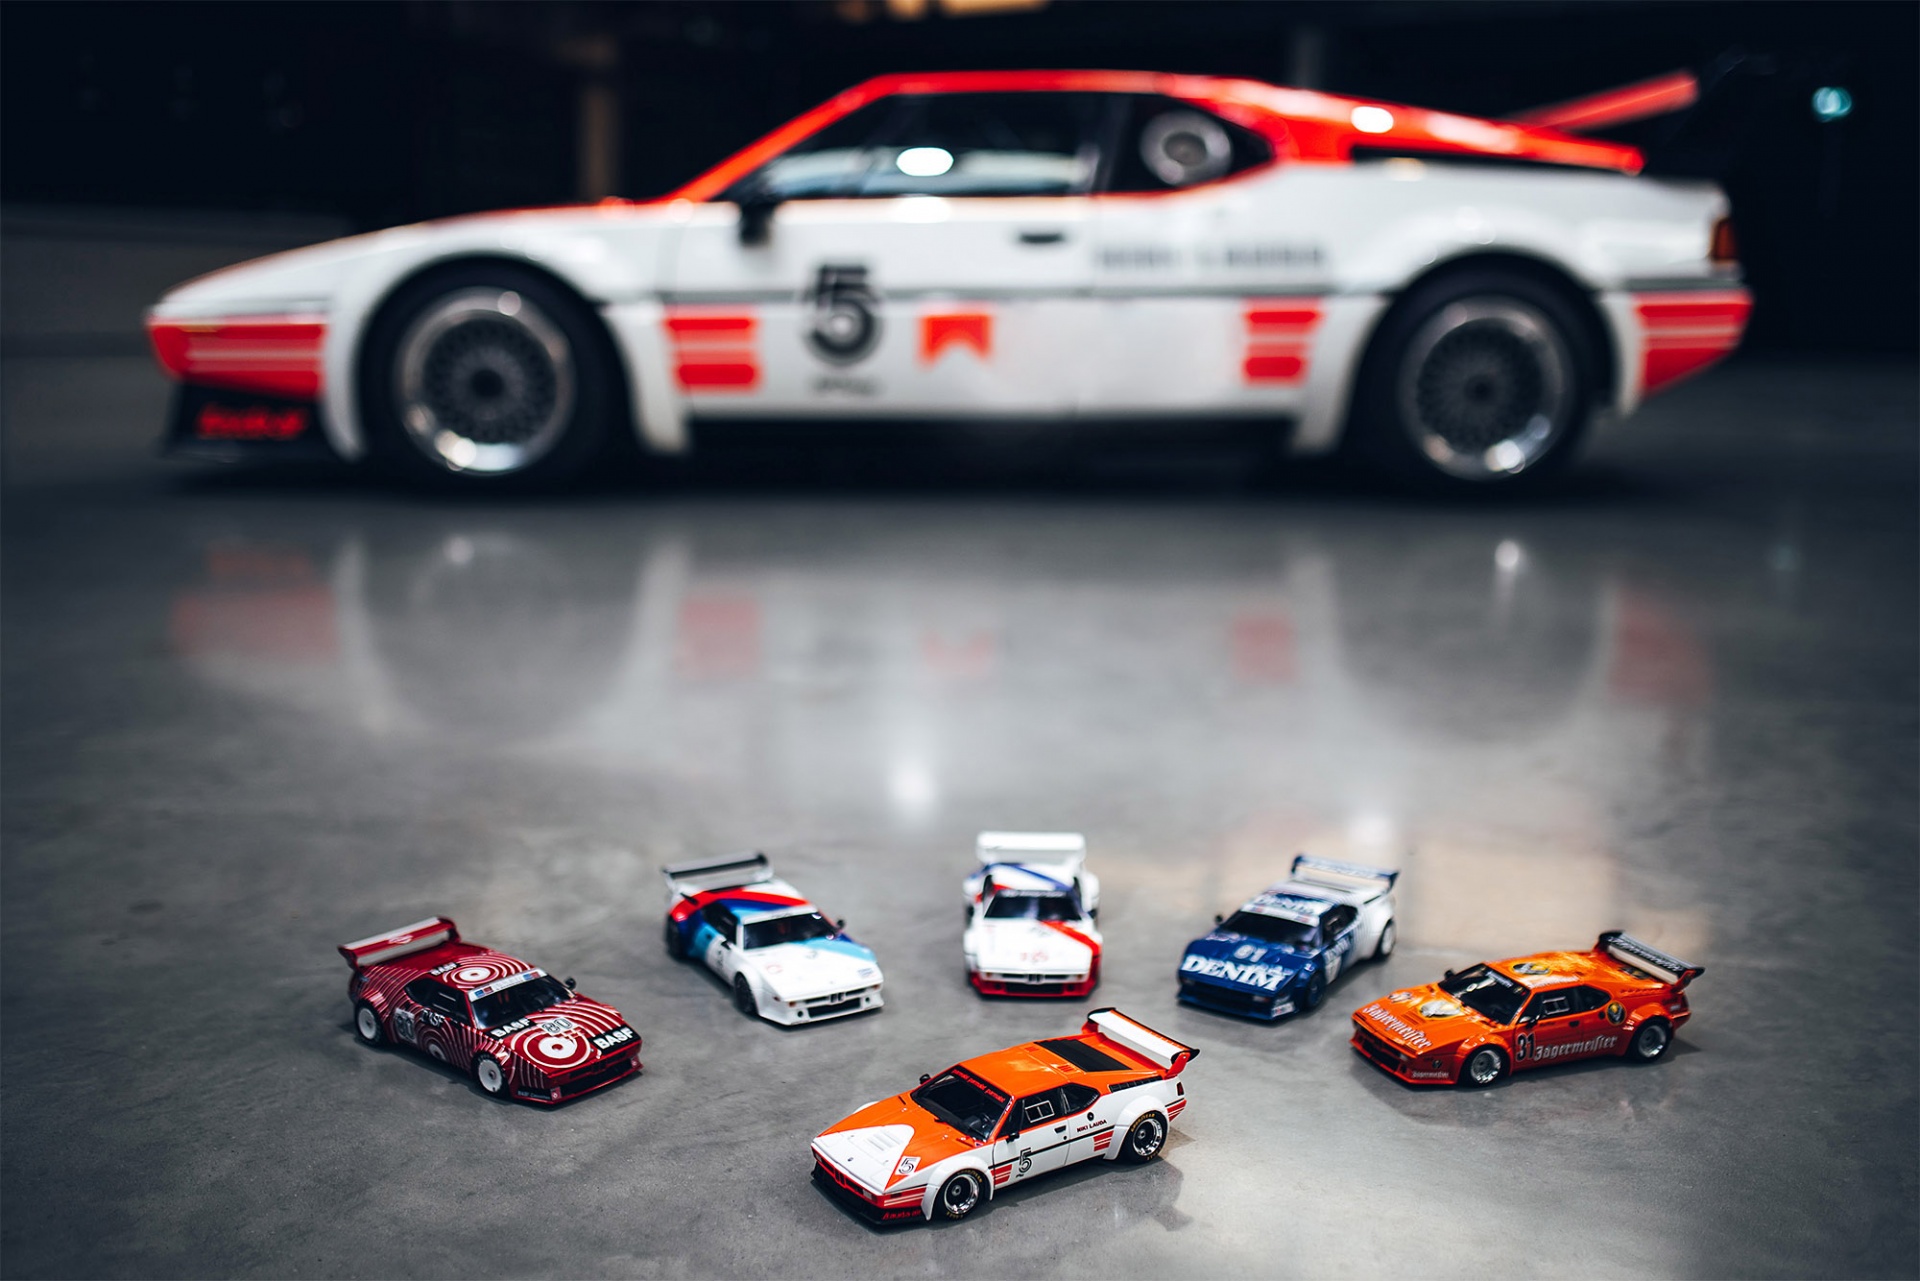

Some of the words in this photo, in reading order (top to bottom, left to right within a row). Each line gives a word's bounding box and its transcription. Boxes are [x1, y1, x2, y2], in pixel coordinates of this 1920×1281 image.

[804, 261, 882, 368] 5
[1181, 954, 1286, 991] DENIM
[490, 1017, 531, 1038] BASF
[541, 1018, 573, 1034] 80
[593, 1027, 634, 1049] BASF
[1516, 1031, 1535, 1062] 31
[1089, 1119, 1108, 1129] LAUDA
[898, 1157, 915, 1174] 5
[1018, 1147, 1033, 1174] 5
